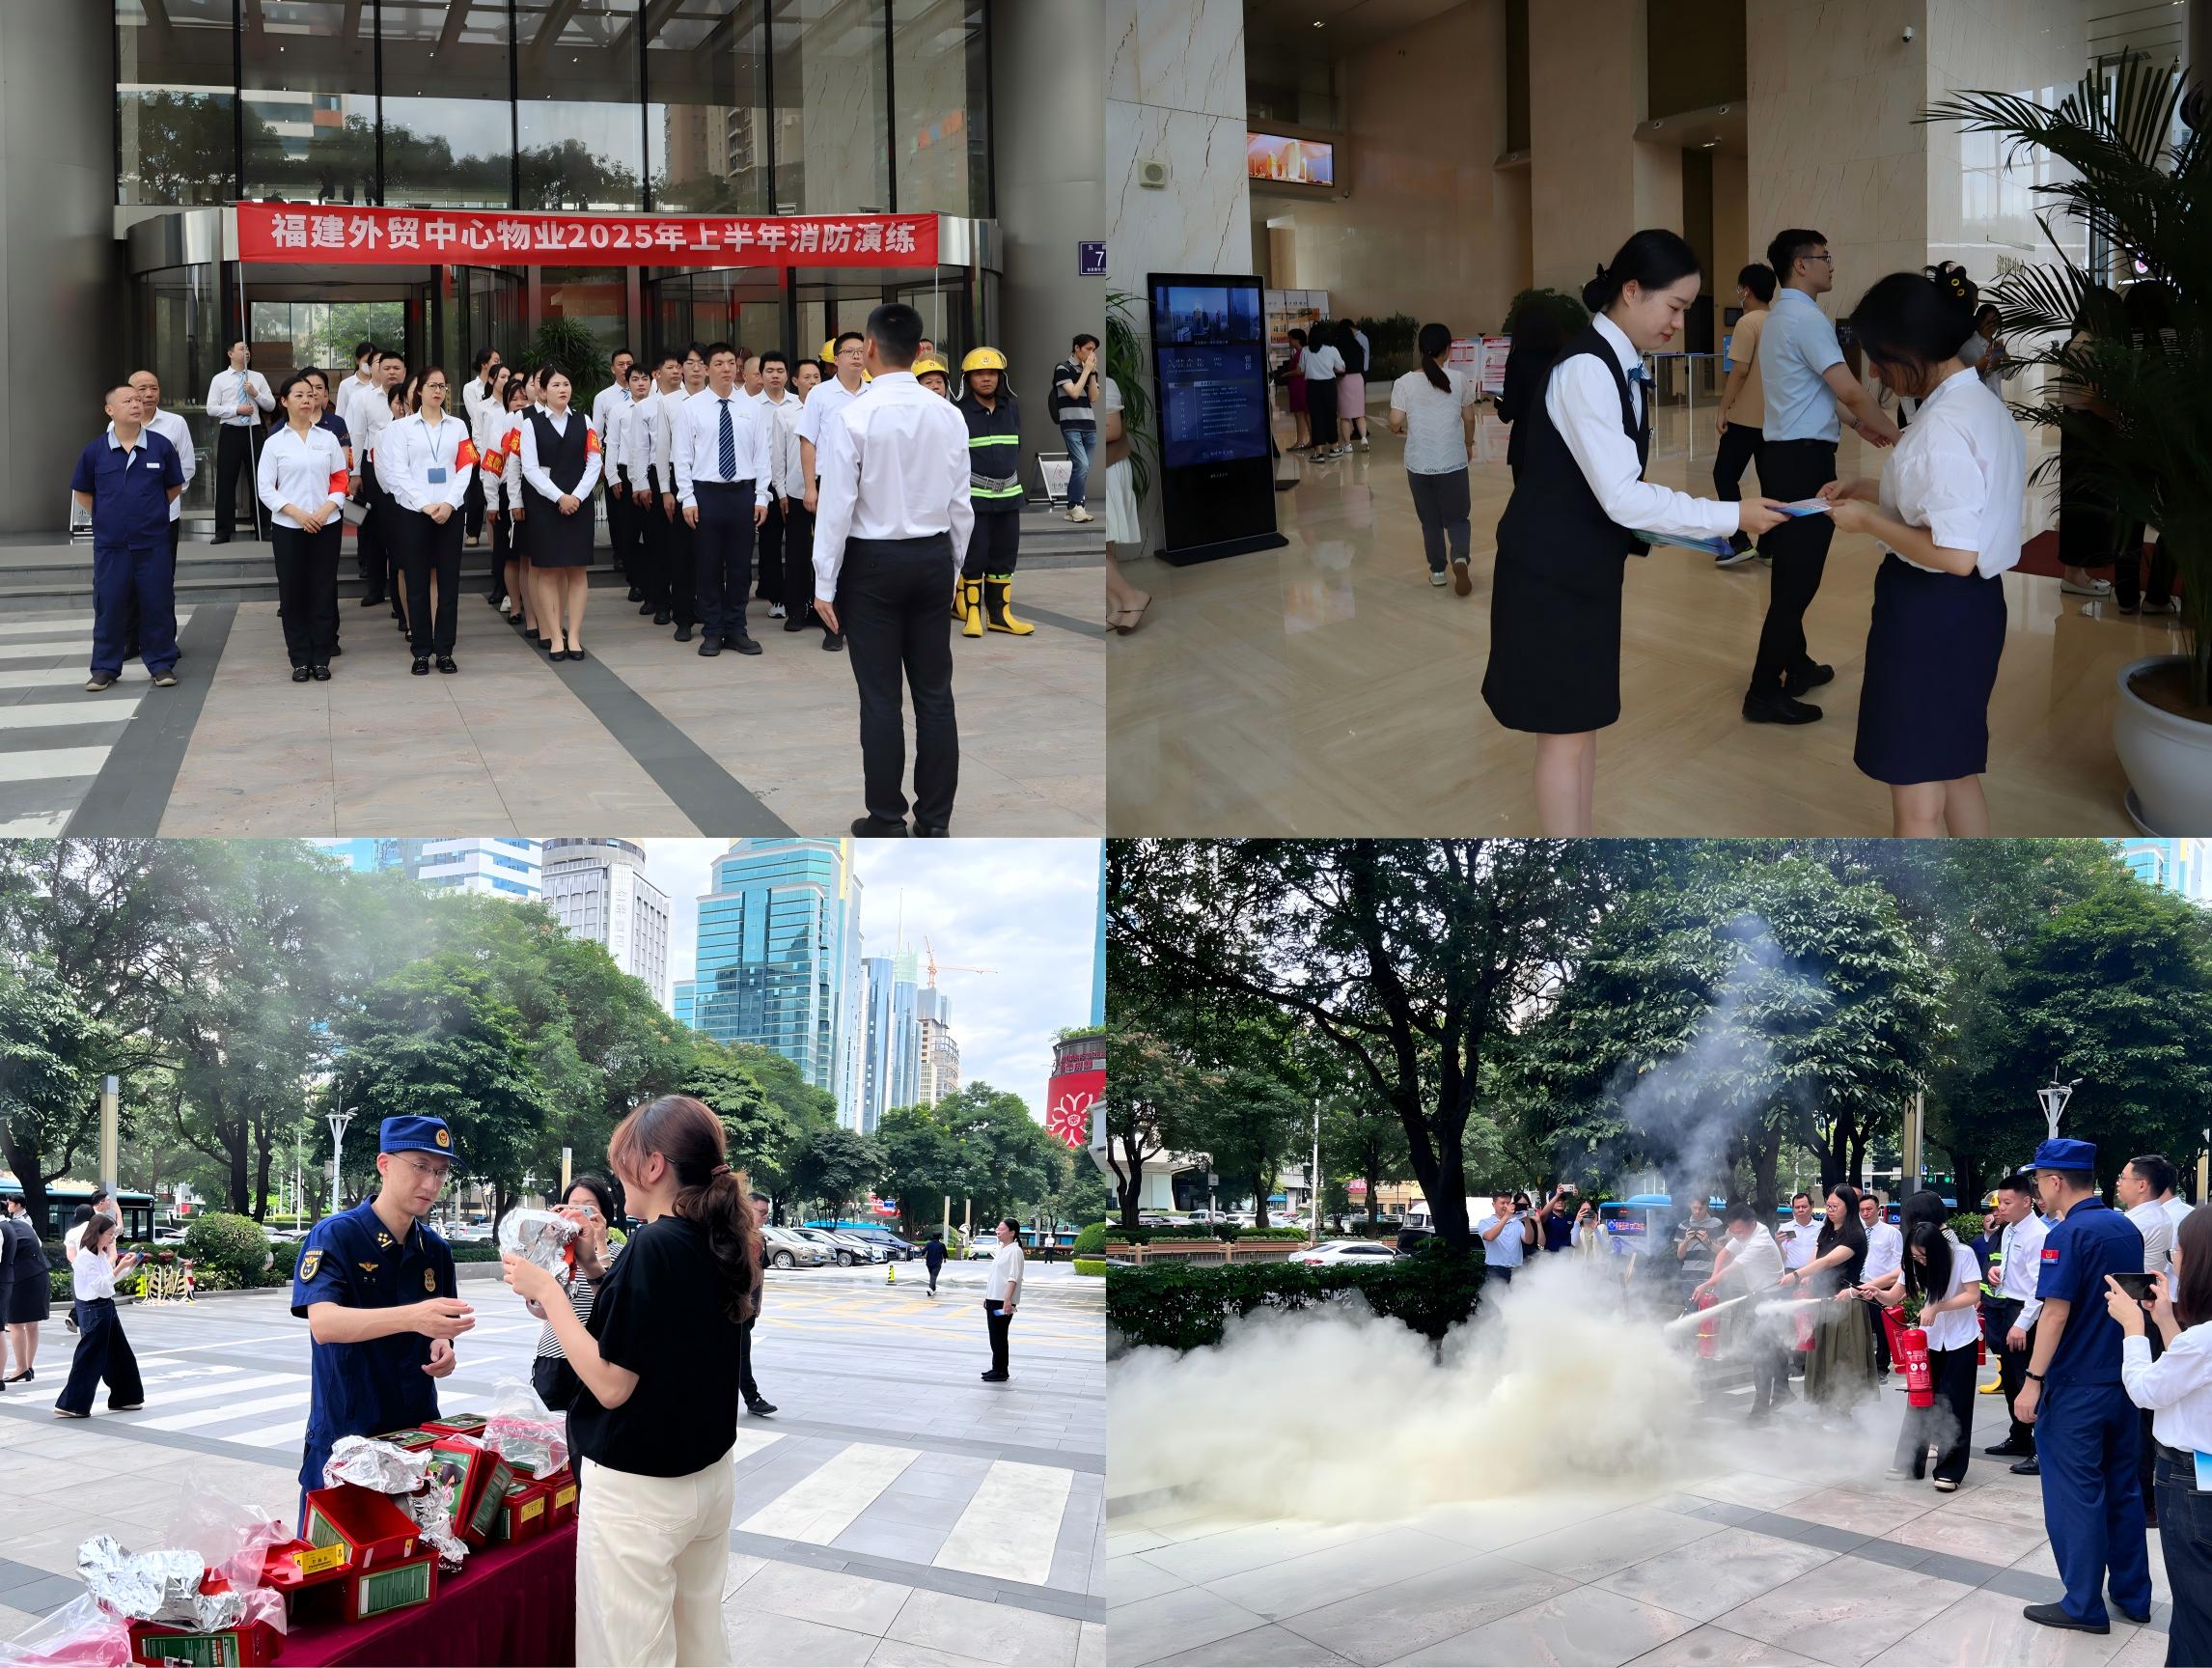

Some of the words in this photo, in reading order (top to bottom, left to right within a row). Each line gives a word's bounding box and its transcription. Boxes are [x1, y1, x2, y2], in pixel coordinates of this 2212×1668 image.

[271, 213, 917, 255] 福建外贸中心物业2025年上半年消防演练
